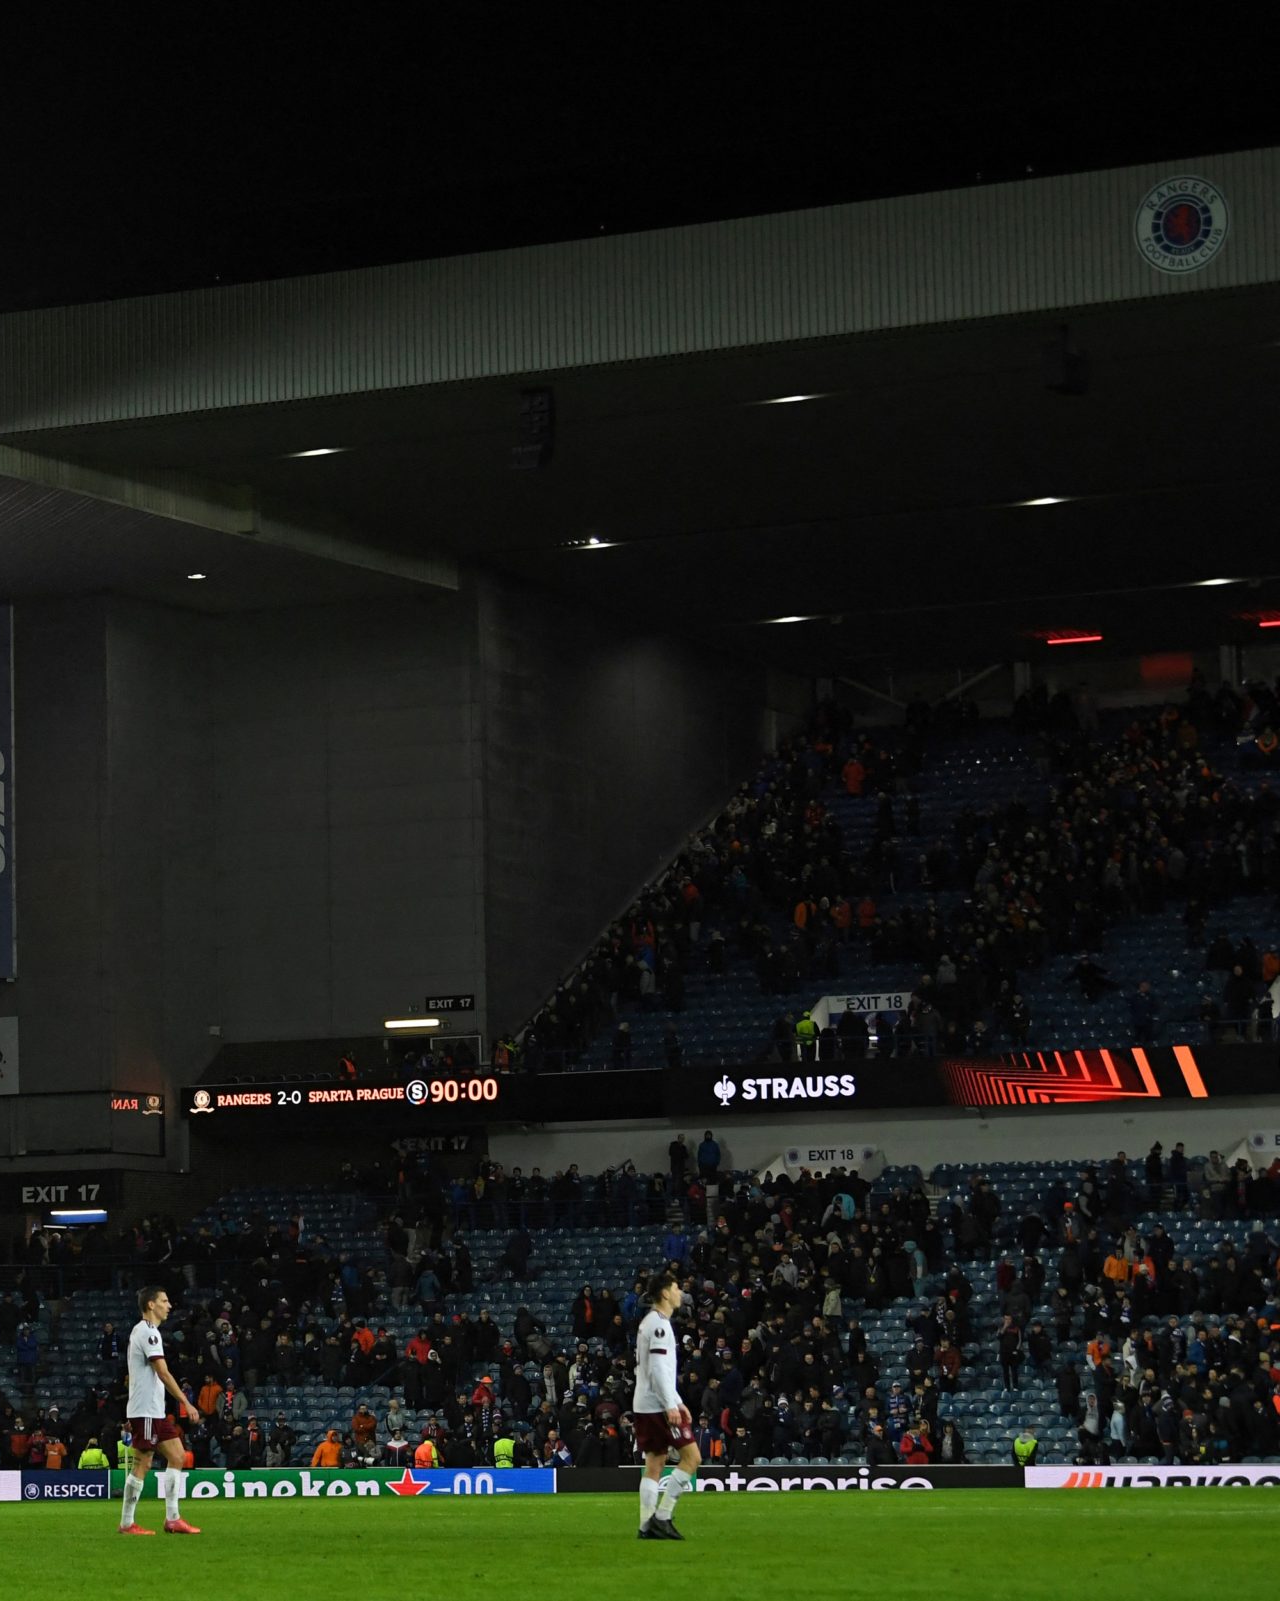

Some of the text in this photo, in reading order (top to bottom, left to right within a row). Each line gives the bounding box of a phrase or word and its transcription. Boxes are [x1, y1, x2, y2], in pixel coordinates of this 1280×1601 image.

[1146, 181, 1217, 211] RANGERS
[1144, 228, 1223, 268] FOOTBALL CLUB
[428, 998, 472, 1009] EXIT 17
[846, 995, 902, 1010] EXIT 18
[217, 1087, 404, 1107] RANGERS 2-0 SPARTA PRAGUE
[430, 1079, 498, 1102] 90:00
[741, 1075, 856, 1100] STRAUSS
[450, 1137, 469, 1150] 17
[808, 1149, 854, 1161] EXIT 18
[22, 1184, 100, 1203] EXIT 17
[44, 1484, 105, 1498] RESPECT
